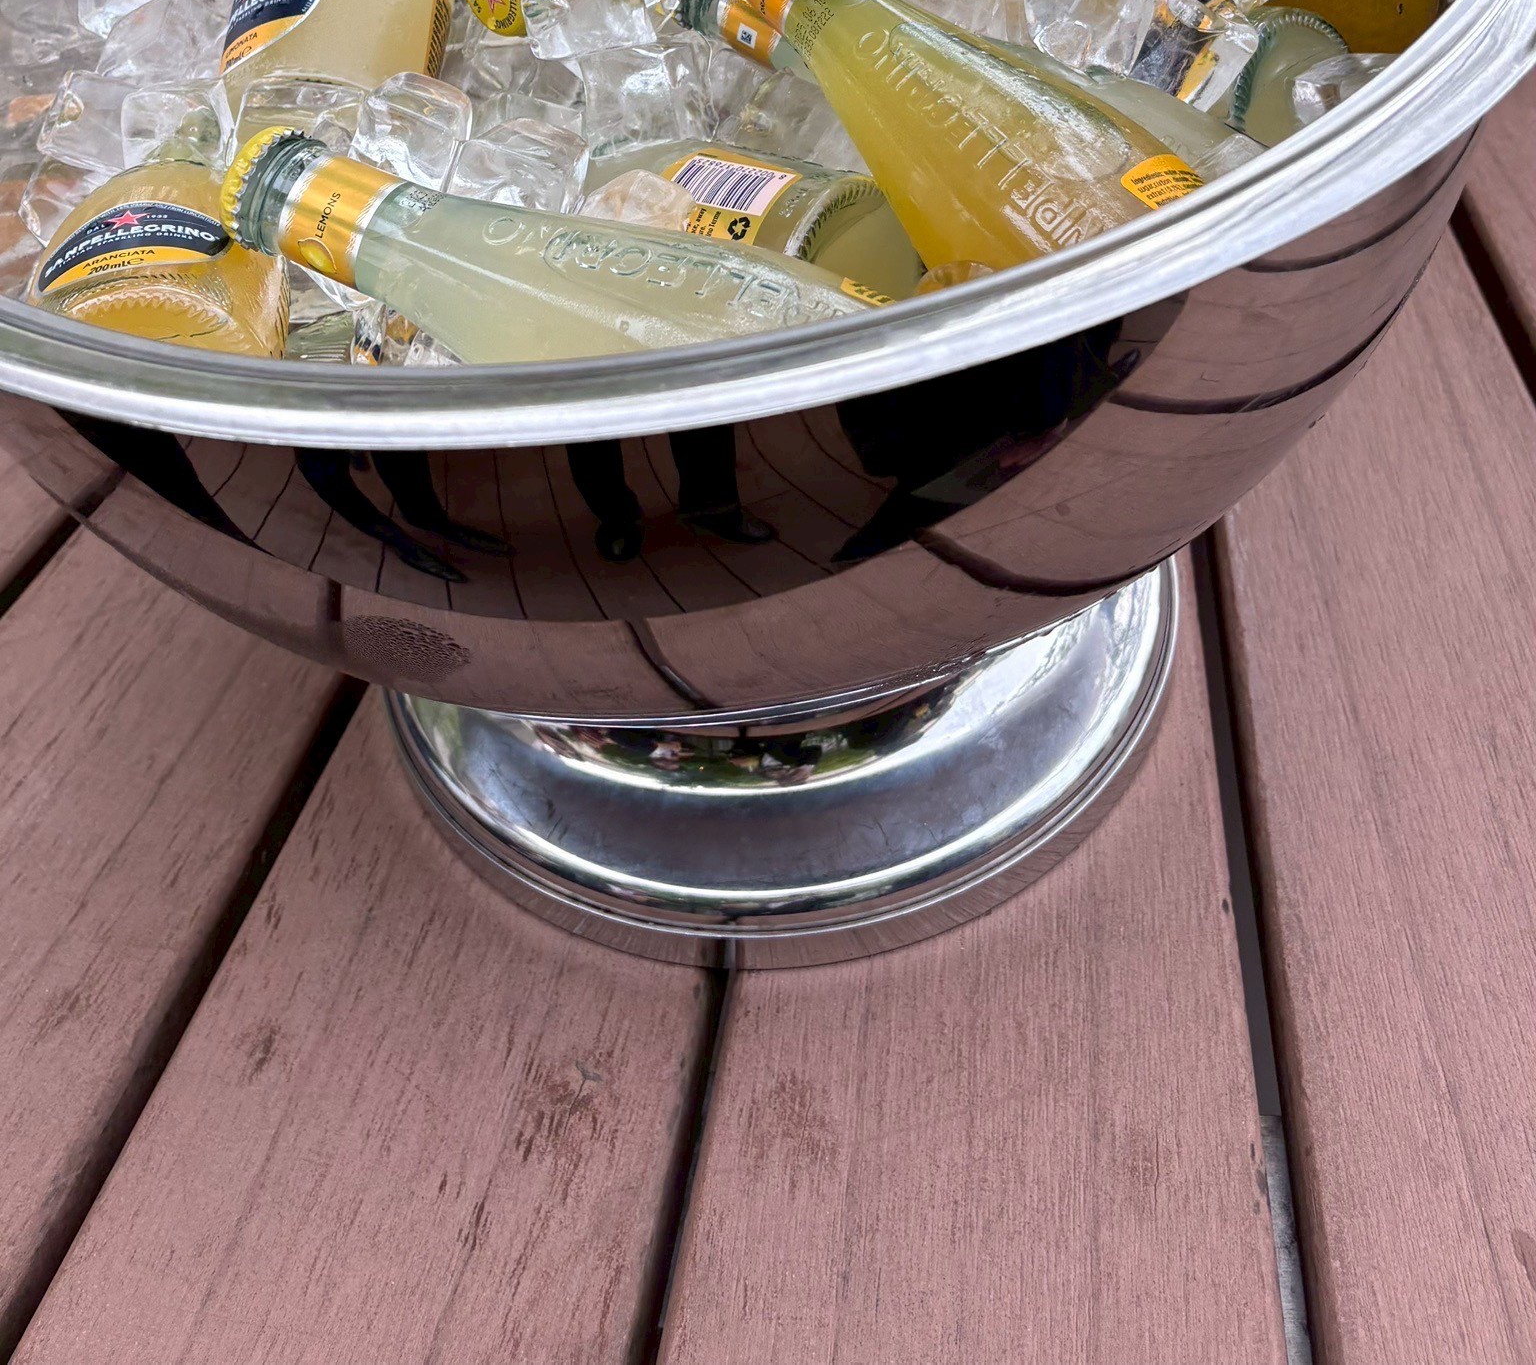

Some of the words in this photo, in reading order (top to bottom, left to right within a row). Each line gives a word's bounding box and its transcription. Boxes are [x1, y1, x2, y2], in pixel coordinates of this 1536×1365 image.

[315, 192, 342, 239] LEMONS
[45, 224, 216, 278] SANPELLEGRINO
[156, 232, 193, 240] DRINKS
[83, 249, 155, 270] ARANCIATA
